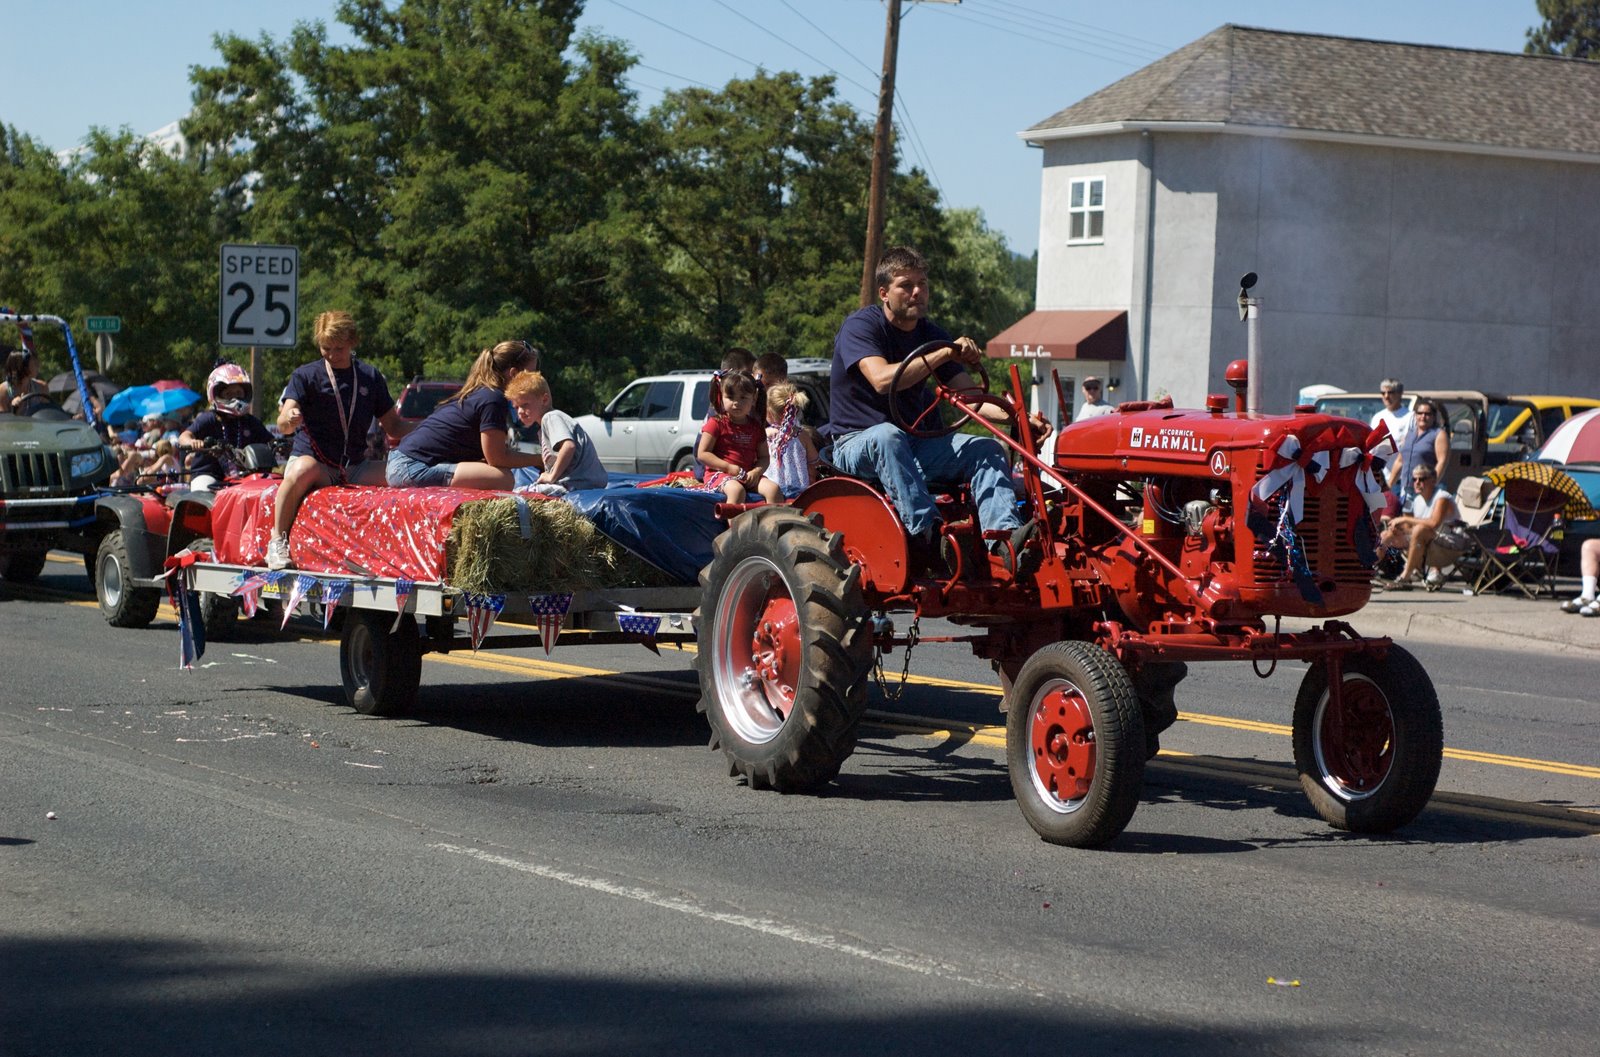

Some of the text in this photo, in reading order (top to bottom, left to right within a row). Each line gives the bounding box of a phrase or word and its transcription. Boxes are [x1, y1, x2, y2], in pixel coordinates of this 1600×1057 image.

[226, 255, 293, 275] SPEED
[226, 281, 291, 337] 25
[1144, 434, 1206, 453] FARMALL
[1214, 454, 1223, 470] A
